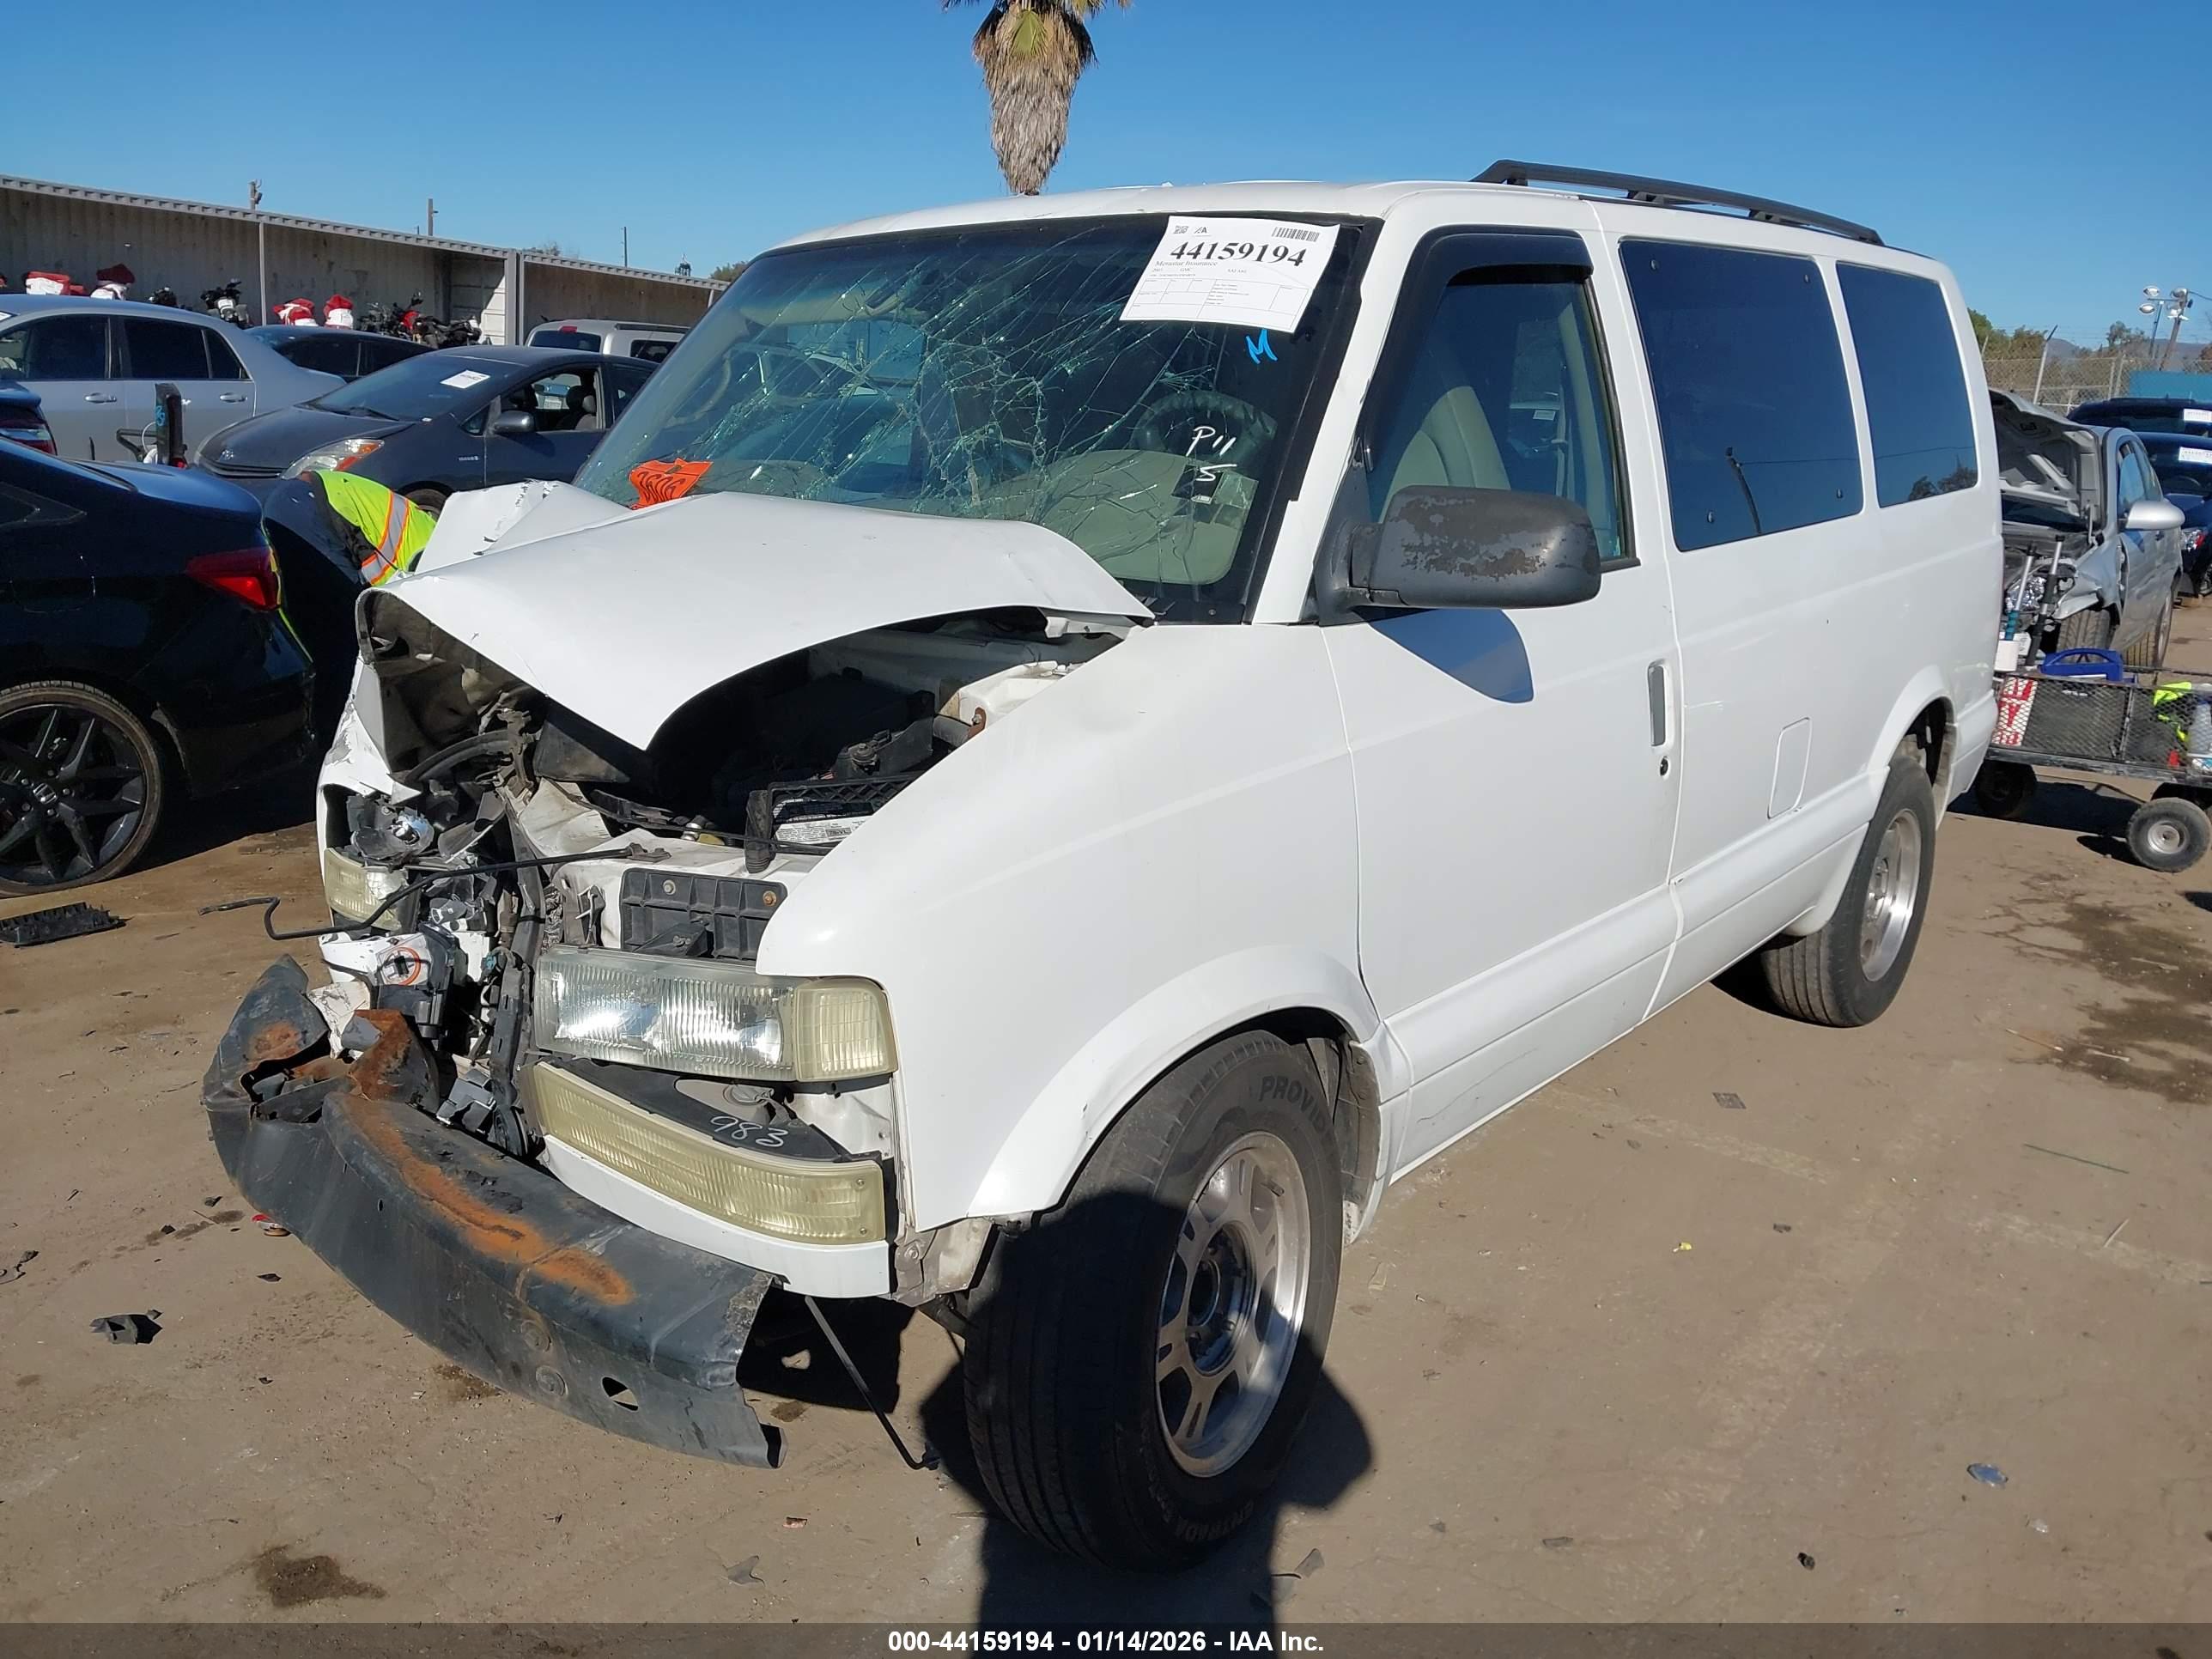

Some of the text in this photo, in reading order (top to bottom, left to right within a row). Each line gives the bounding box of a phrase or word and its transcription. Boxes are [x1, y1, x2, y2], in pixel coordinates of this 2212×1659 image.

[1170, 240, 1307, 268] 44159194
[1246, 329, 1278, 364] M
[710, 1115, 789, 1147] 983
